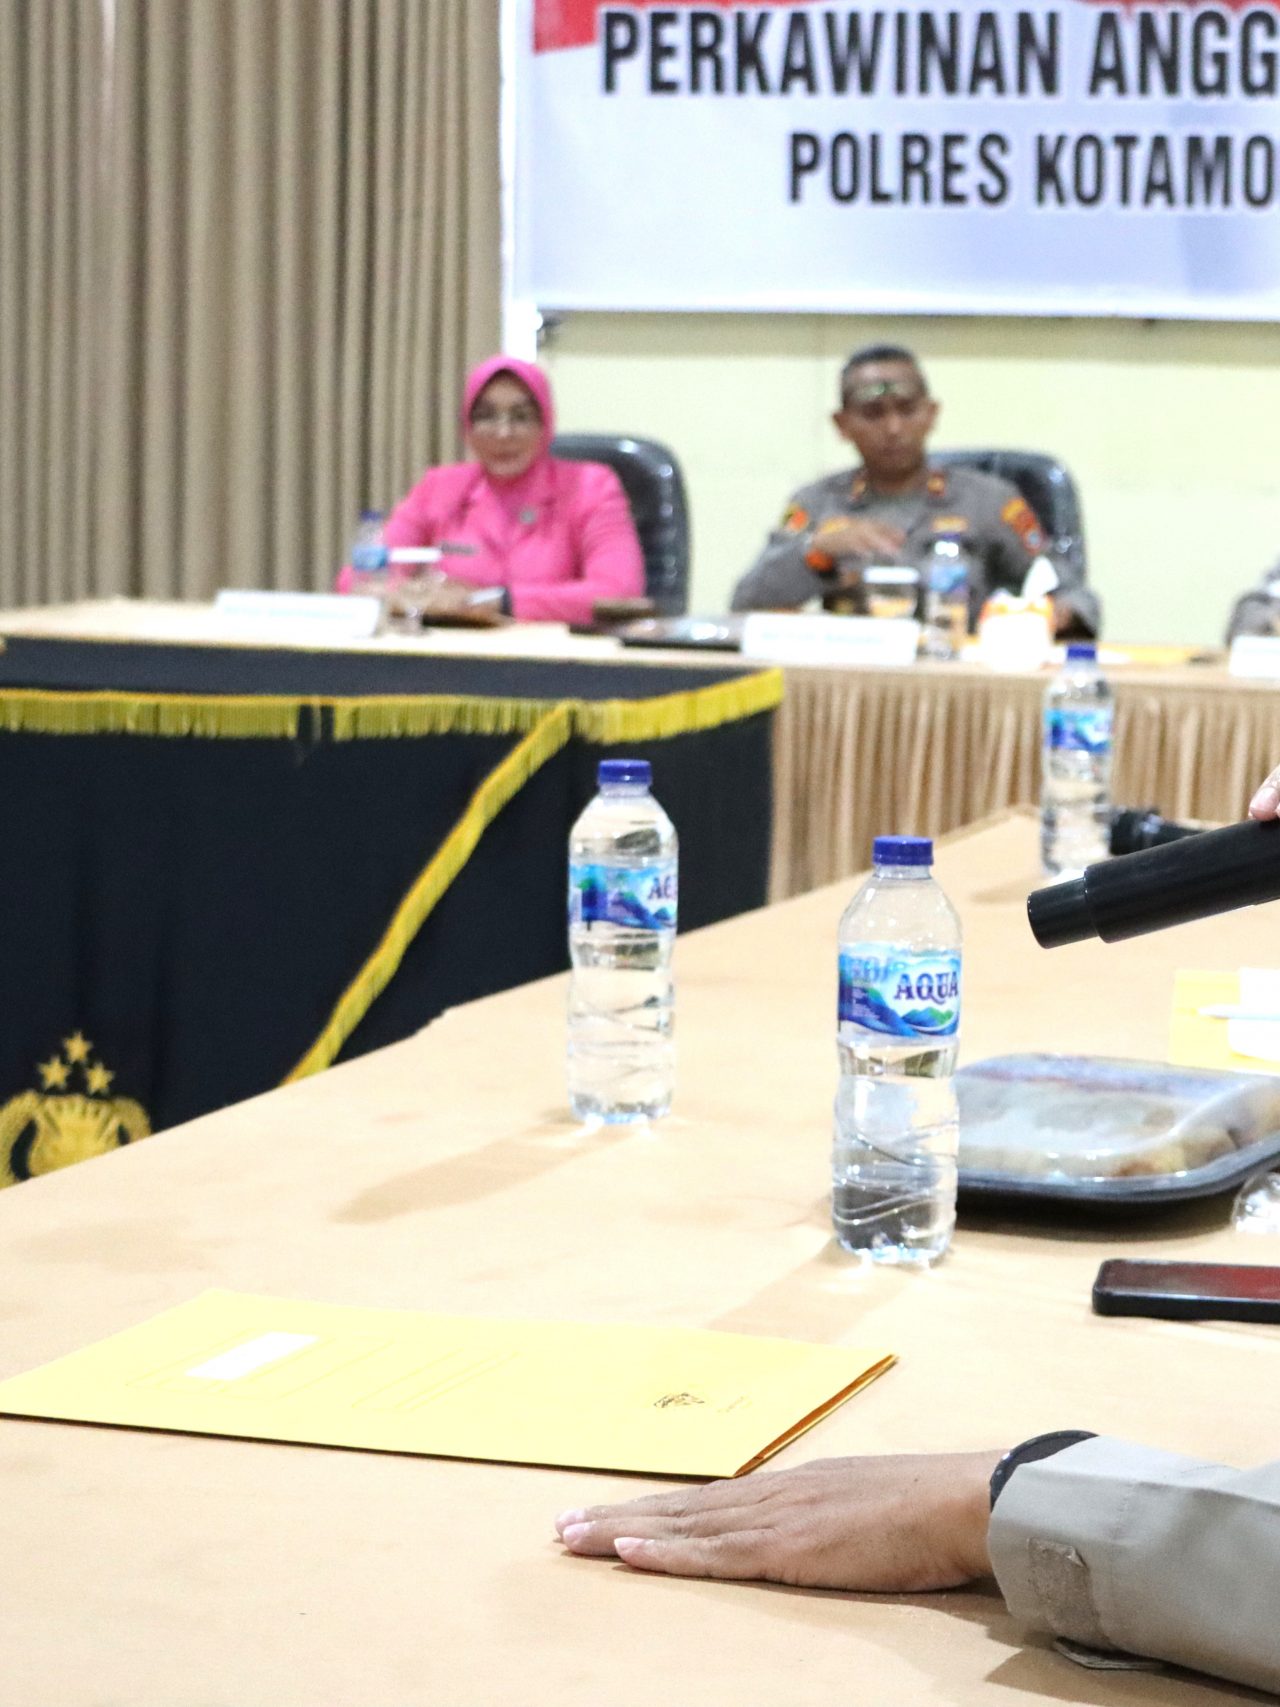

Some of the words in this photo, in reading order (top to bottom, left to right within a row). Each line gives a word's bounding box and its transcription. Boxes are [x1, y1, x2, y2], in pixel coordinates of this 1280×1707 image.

[602, 10, 1060, 96] PERKAWINAN
[789, 131, 1010, 204] POLRES
[893, 970, 959, 1006] AQUA
